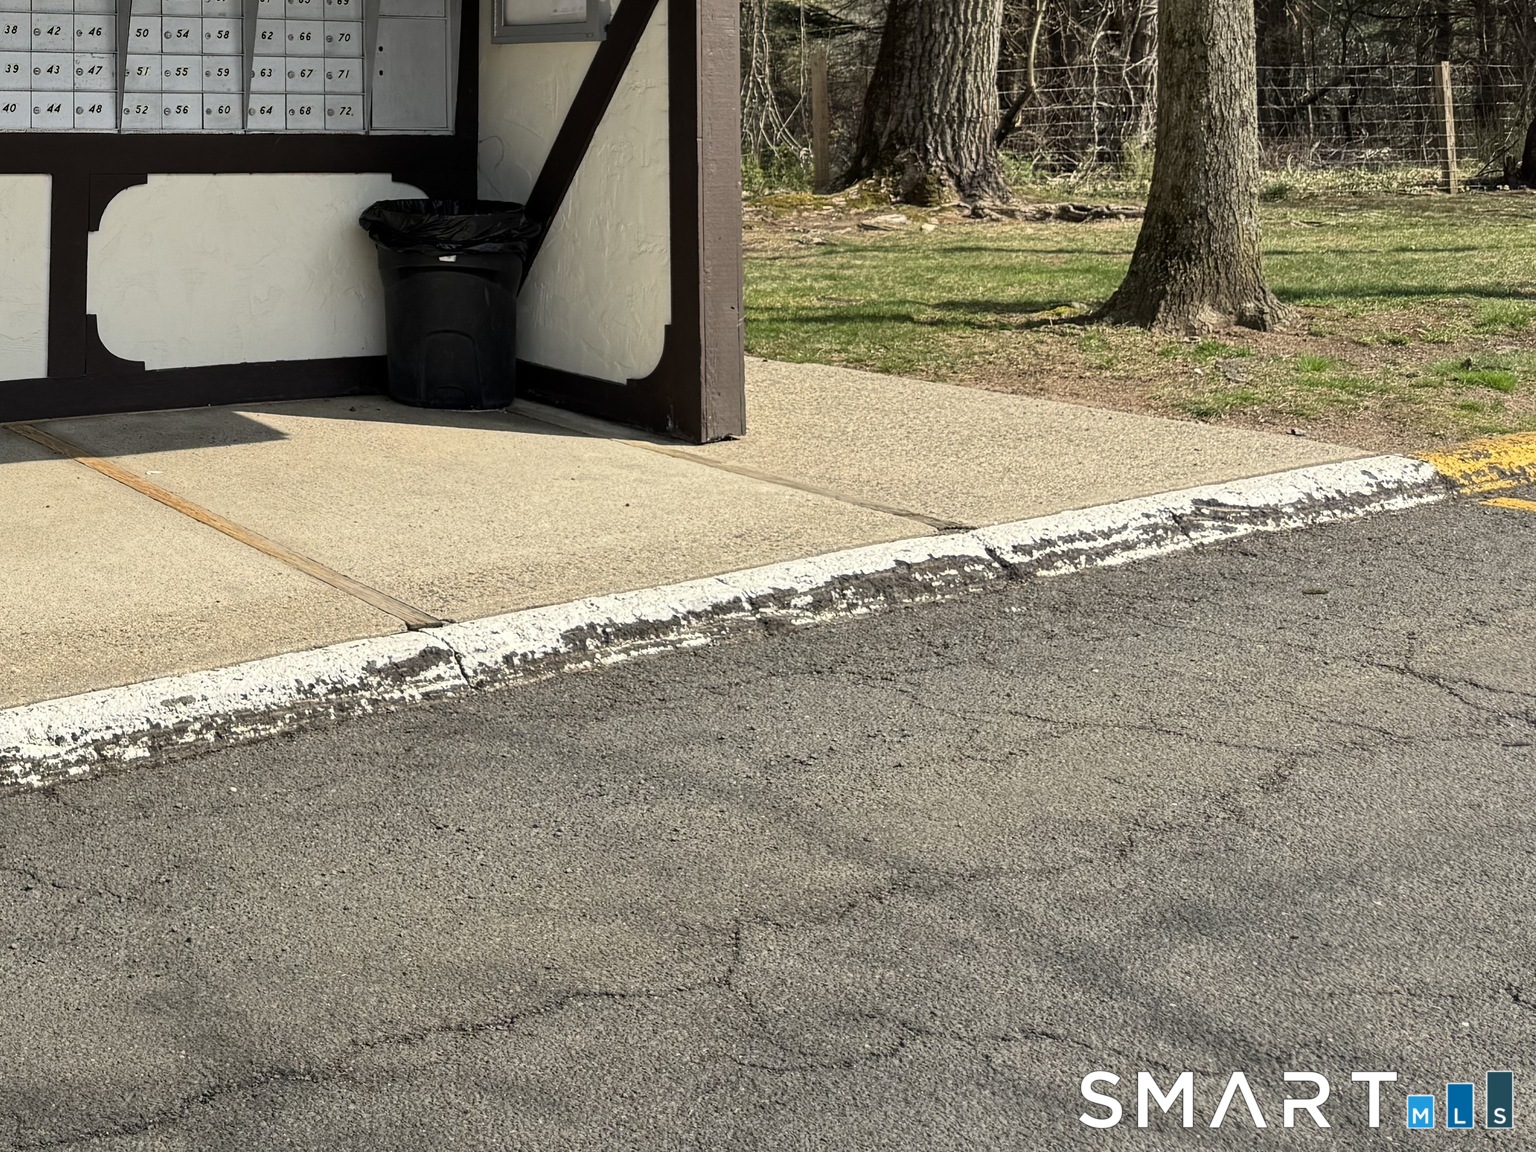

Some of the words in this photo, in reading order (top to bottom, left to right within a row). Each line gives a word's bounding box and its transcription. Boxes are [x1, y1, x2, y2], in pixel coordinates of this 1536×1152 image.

[3, 24, 19, 35] 38
[46, 25, 62, 36] 42
[87, 26, 103, 37] 46
[134, 27, 150, 38] 50
[175, 28, 190, 39] 54
[216, 29, 231, 40] 58
[260, 30, 274, 41] 62
[299, 31, 312, 42] 66
[337, 32, 352, 43] 70
[4, 63, 20, 74] 39
[45, 64, 61, 75] 43
[87, 64, 104, 76] 47
[136, 66, 150, 77] 51
[174, 66, 190, 77] 55
[216, 67, 230, 78] 59
[259, 67, 273, 78] 63
[299, 68, 314, 79] 67
[336, 69, 350, 80] 71
[1, 102, 17, 113] 40
[46, 103, 62, 114] 44
[87, 103, 103, 114] 48
[134, 104, 149, 115] 52
[174, 104, 189, 115] 56
[217, 104, 232, 115] 60
[259, 105, 274, 116] 64
[298, 105, 312, 116] 68
